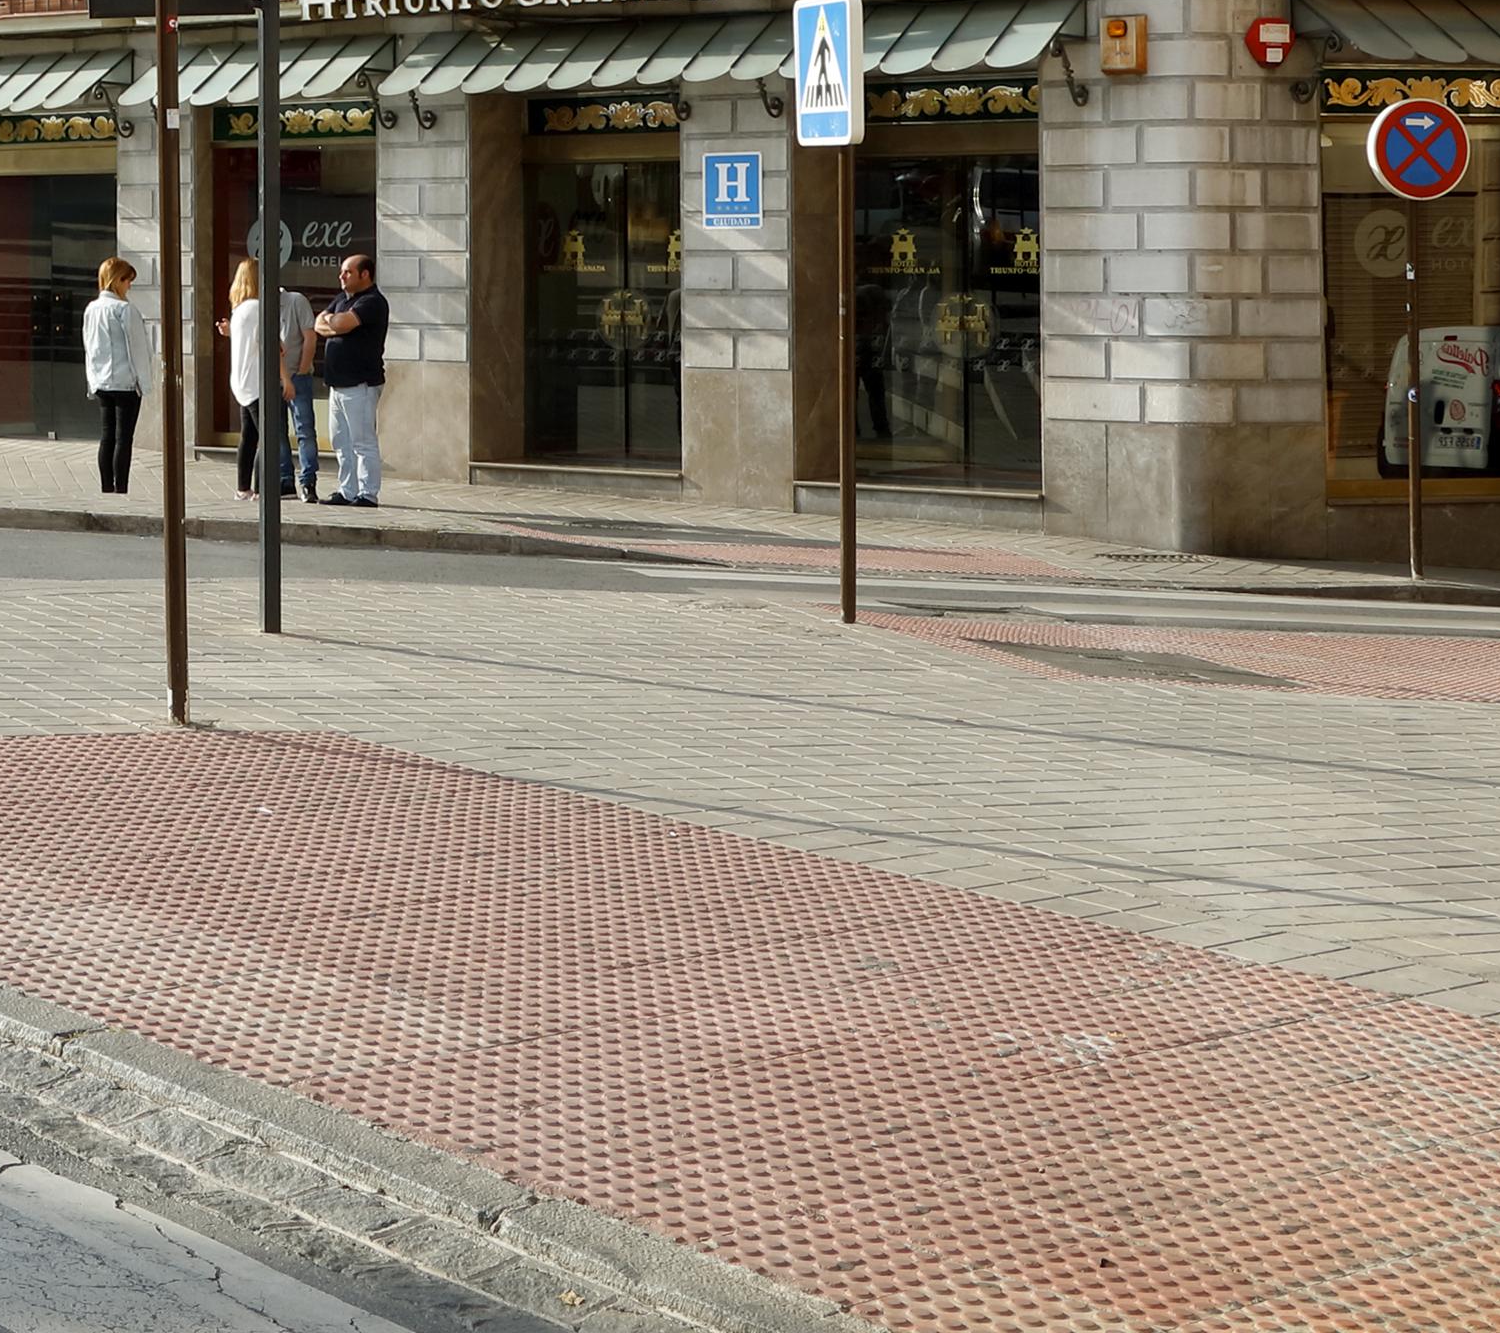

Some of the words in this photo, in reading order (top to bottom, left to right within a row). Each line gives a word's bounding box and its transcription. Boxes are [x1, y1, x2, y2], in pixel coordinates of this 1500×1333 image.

[714, 162, 750, 202] H
[301, 221, 352, 248] exe
[713, 218, 751, 226] CIUDAD
